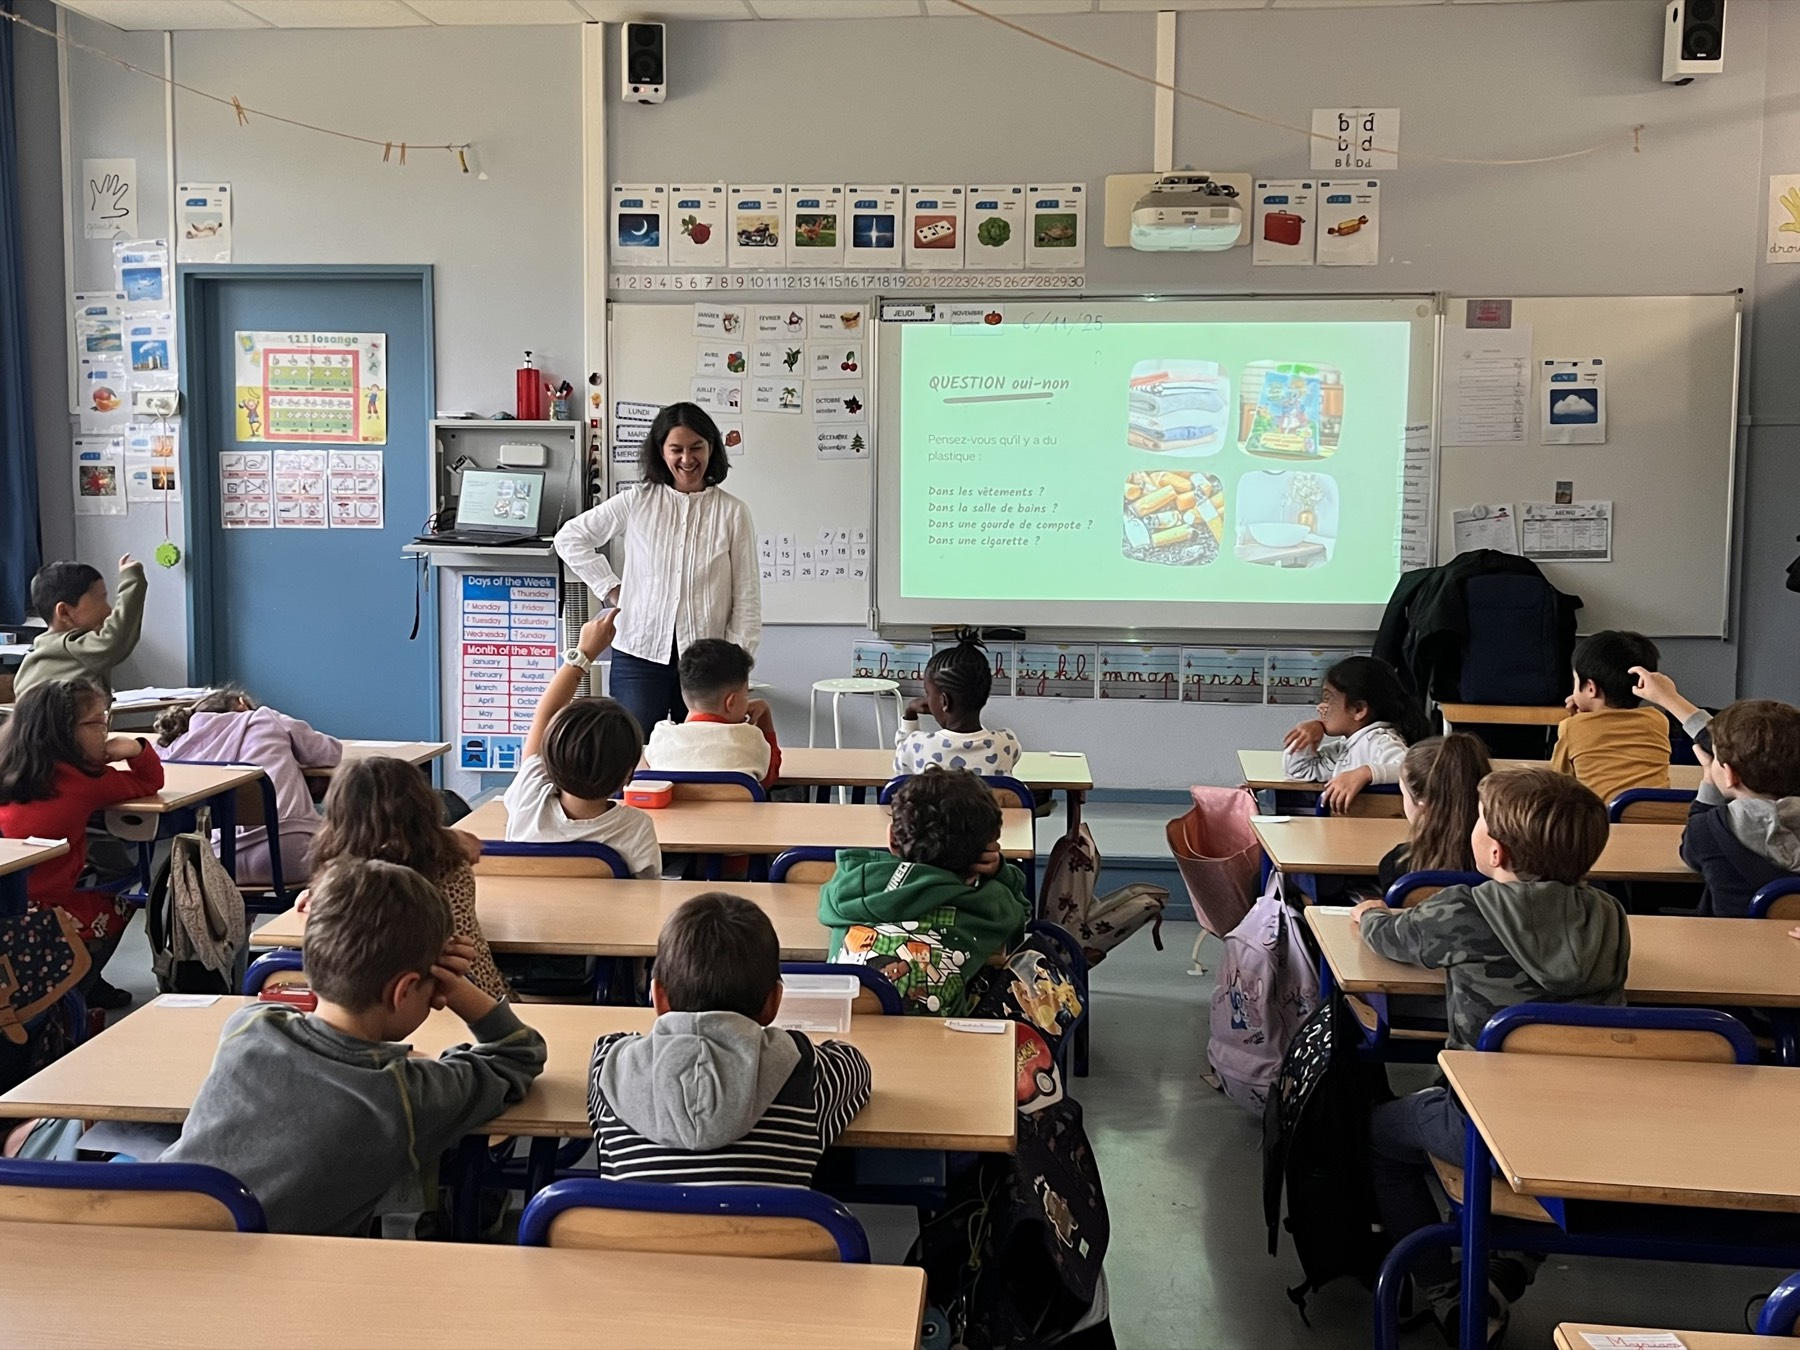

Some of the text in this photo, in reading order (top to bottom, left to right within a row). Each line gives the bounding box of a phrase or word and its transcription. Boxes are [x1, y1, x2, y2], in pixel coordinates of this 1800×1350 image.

[616, 277, 1084, 288] 1 2 3 4 5 6 7 8 9 10 11 12 13 14 15 16 17 18 19 20 21 22 23 24 25 26 27 28 29 30
[312, 335, 359, 346] losange
[929, 376, 1070, 392] QUESTION oui-non
[928, 434, 1057, 447] Pensez-vous qu'il y a du
[928, 451, 976, 462] plastique
[928, 486, 1045, 496] Dans les vêtements ?
[928, 503, 1058, 513] Dans la salle de bains ?
[928, 519, 954, 528] Dans
[981, 520, 1015, 531] gourde
[1020, 520, 1032, 529] de
[1036, 521, 1081, 531] compote
[1088, 520, 1093, 530] ?
[928, 536, 954, 544] Dans
[981, 536, 1029, 548] cigarette
[1034, 536, 1040, 546] ?
[468, 577, 551, 587] Days of the Week
[517, 590, 549, 598] Thursday
[522, 604, 544, 612] Friday
[518, 618, 548, 626] Saturday
[467, 645, 551, 655] Month of the Year
[897, 670, 906, 679] c
[1104, 671, 1126, 682] m
[1127, 672, 1146, 682] n
[1230, 674, 1243, 685] s
[1247, 667, 1261, 686] t
[479, 710, 493, 718] May
[887, 862, 912, 890] INEC
